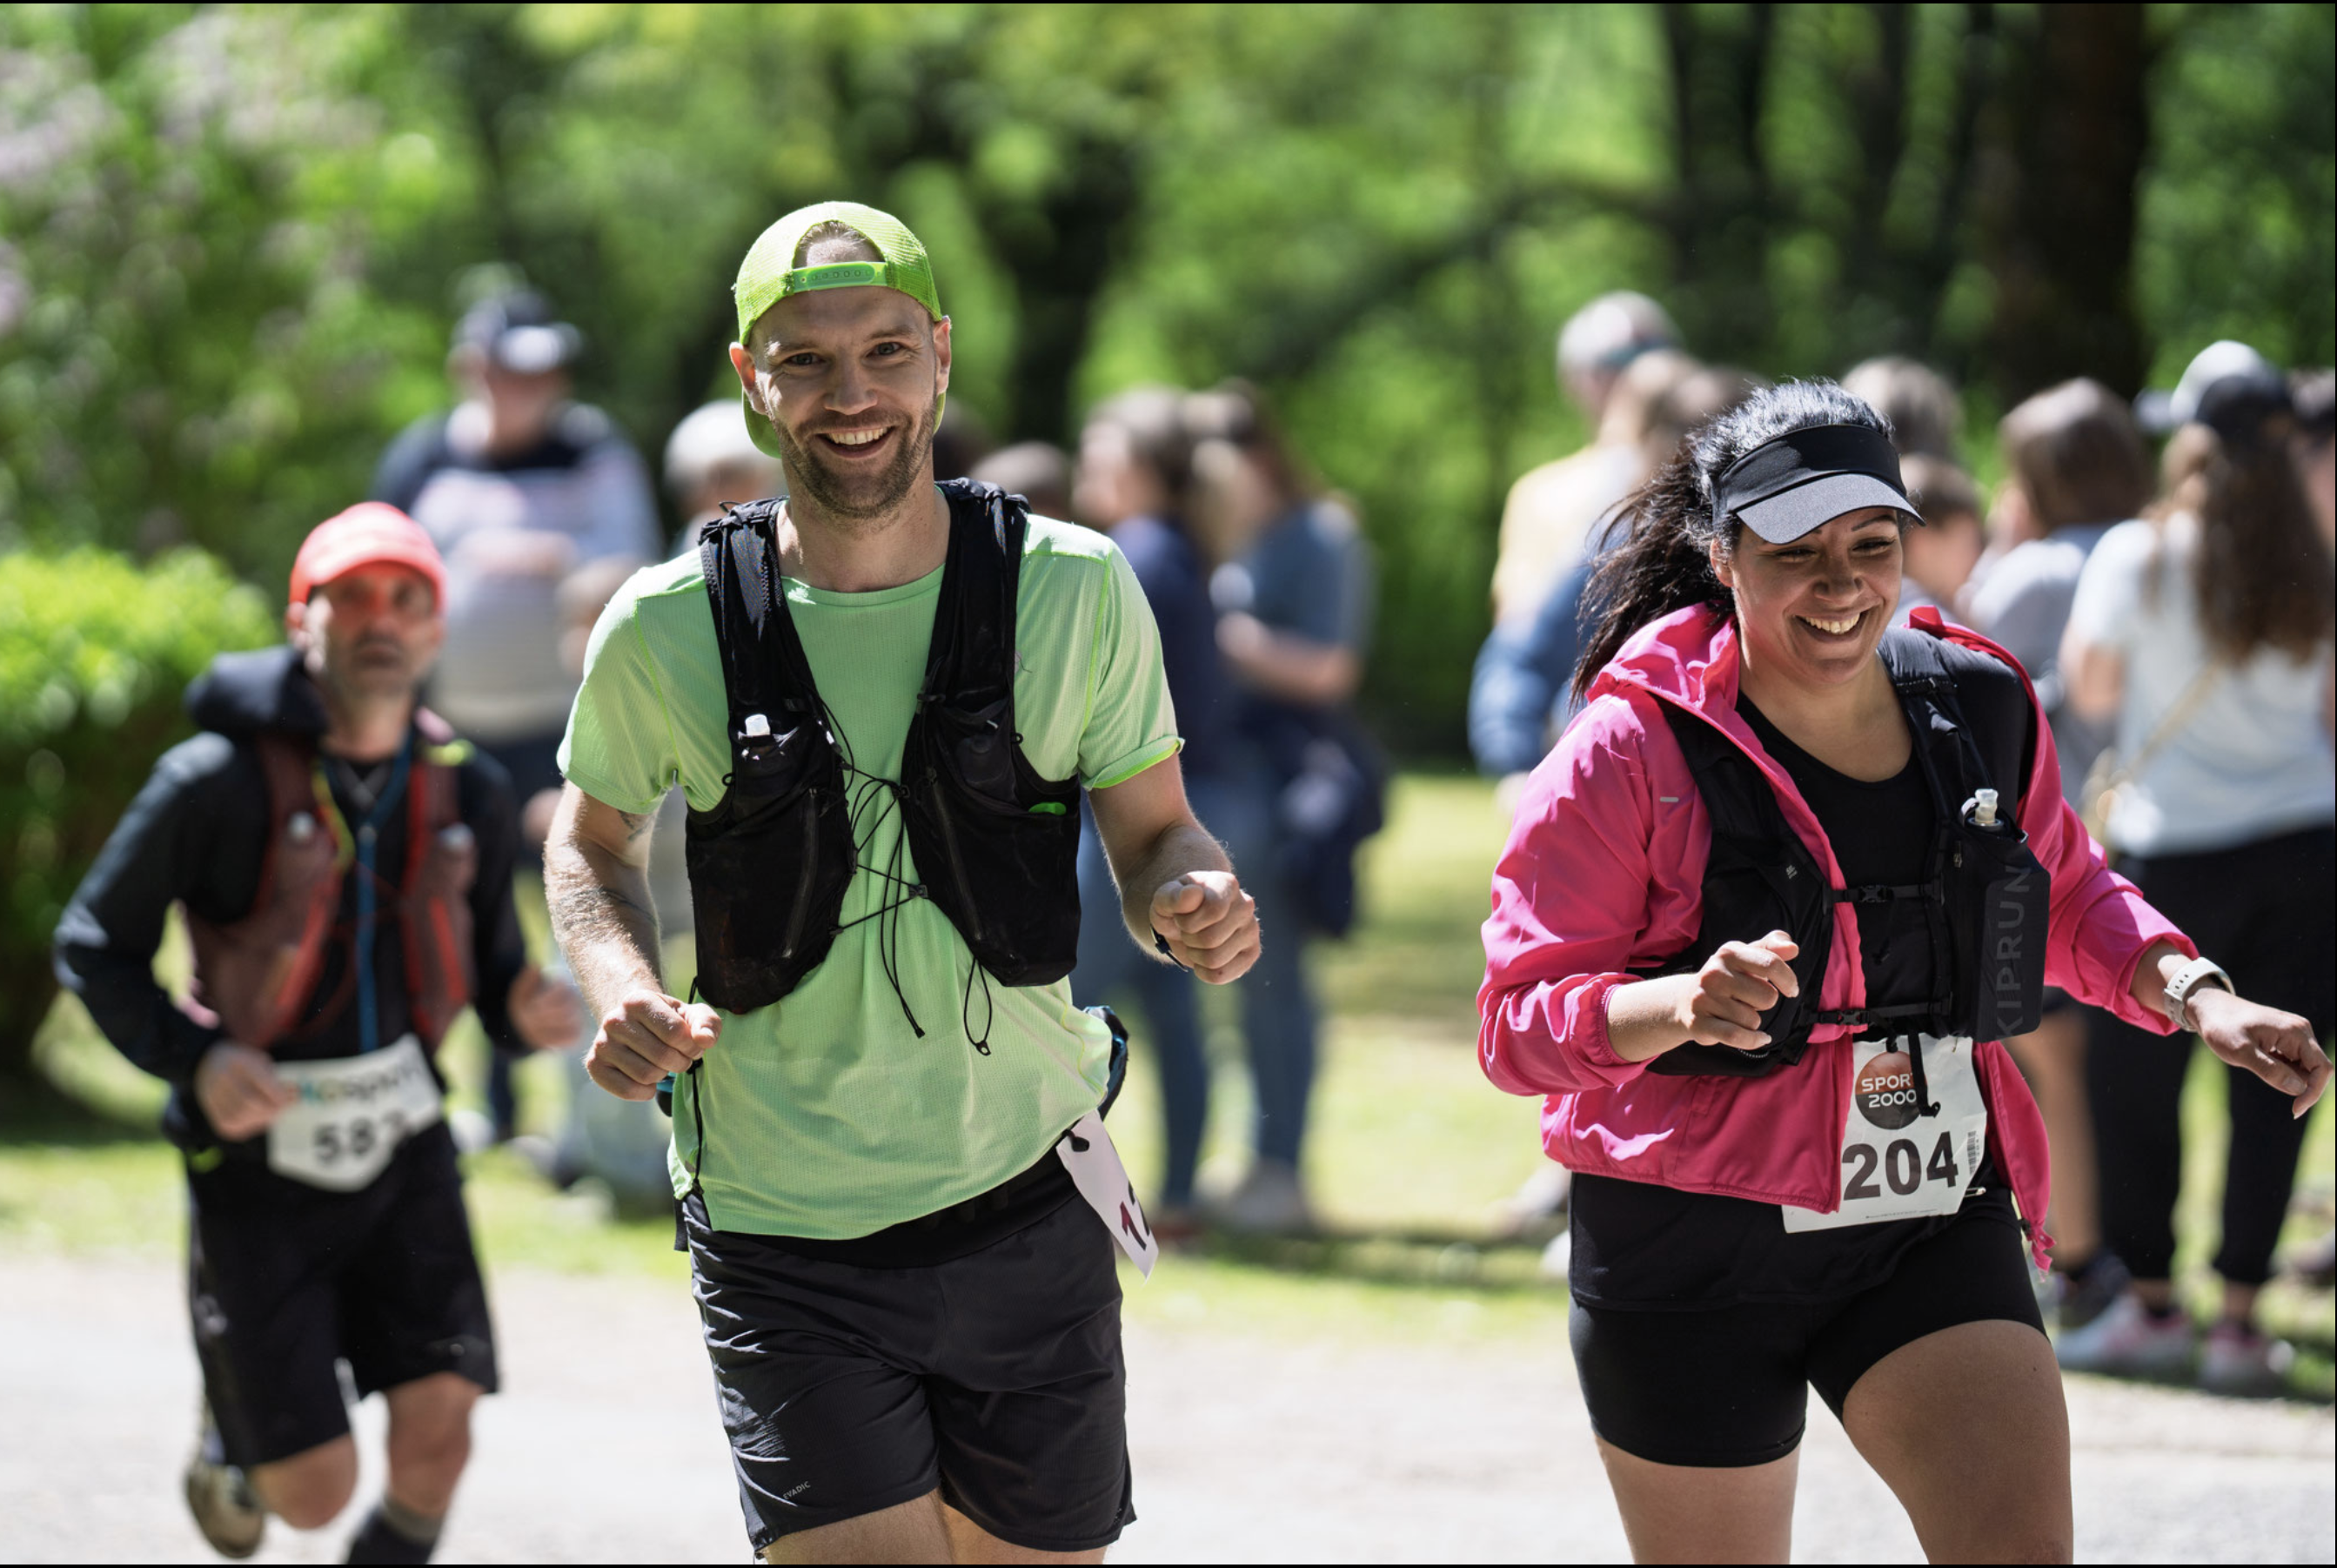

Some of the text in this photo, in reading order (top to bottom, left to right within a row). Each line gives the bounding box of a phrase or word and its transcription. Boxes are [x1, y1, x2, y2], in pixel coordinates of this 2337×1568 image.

[1995, 865, 2032, 1041] KIPRUN
[1861, 1072, 1913, 1092] SPOR
[1868, 1089, 1917, 1109] 2000
[1841, 1130, 1959, 1201] 204
[783, 1480, 811, 1500] EVADIC
